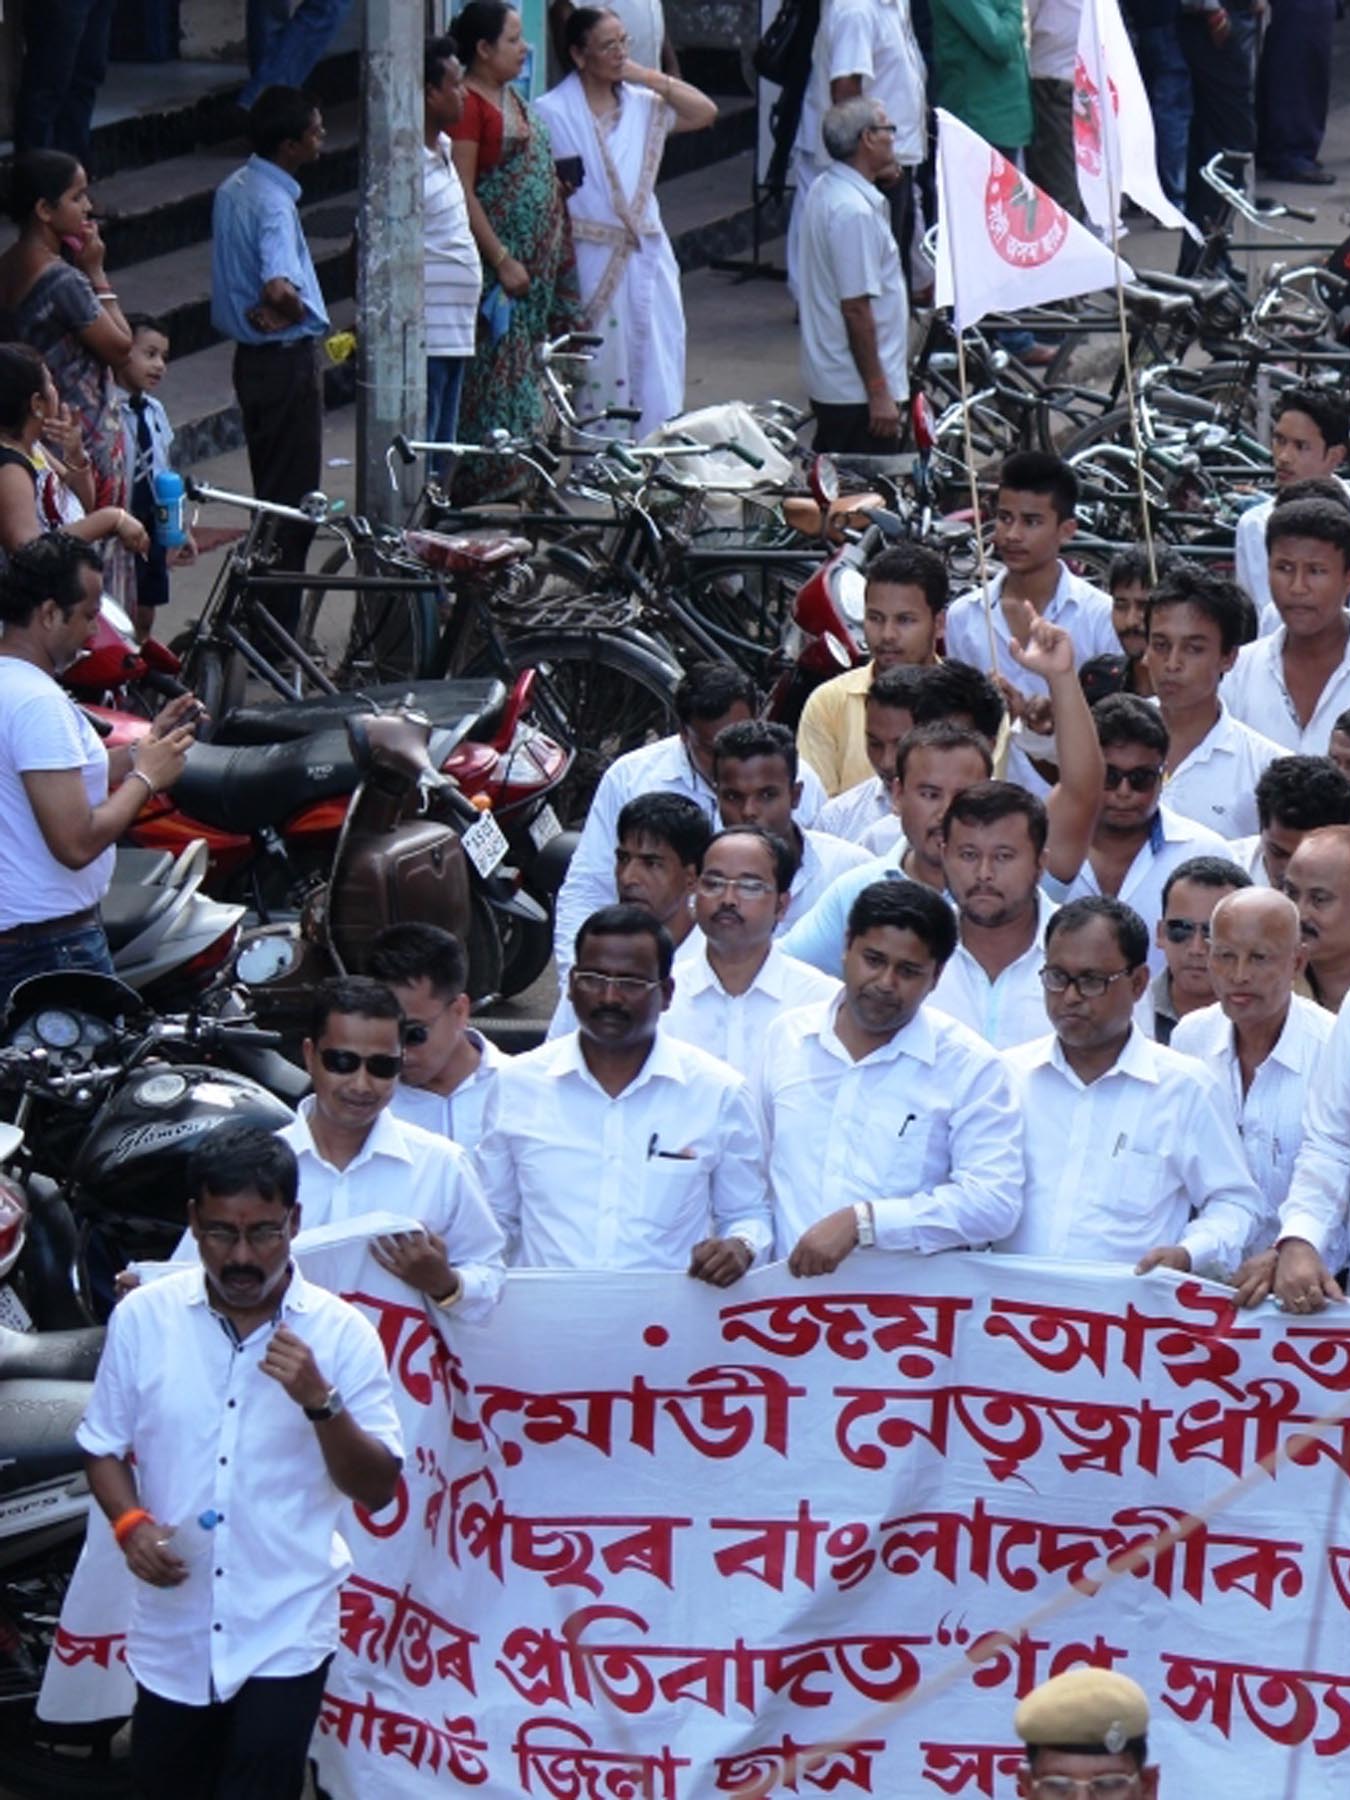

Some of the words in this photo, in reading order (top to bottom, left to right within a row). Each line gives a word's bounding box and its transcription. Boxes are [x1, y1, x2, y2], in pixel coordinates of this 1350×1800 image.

[720, 1293, 972, 1379] জয়
[983, 1281, 1261, 1402] আই
[495, 1604, 932, 1716] প্ৰতিবাদত
[320, 1693, 488, 1786] লাঘাট
